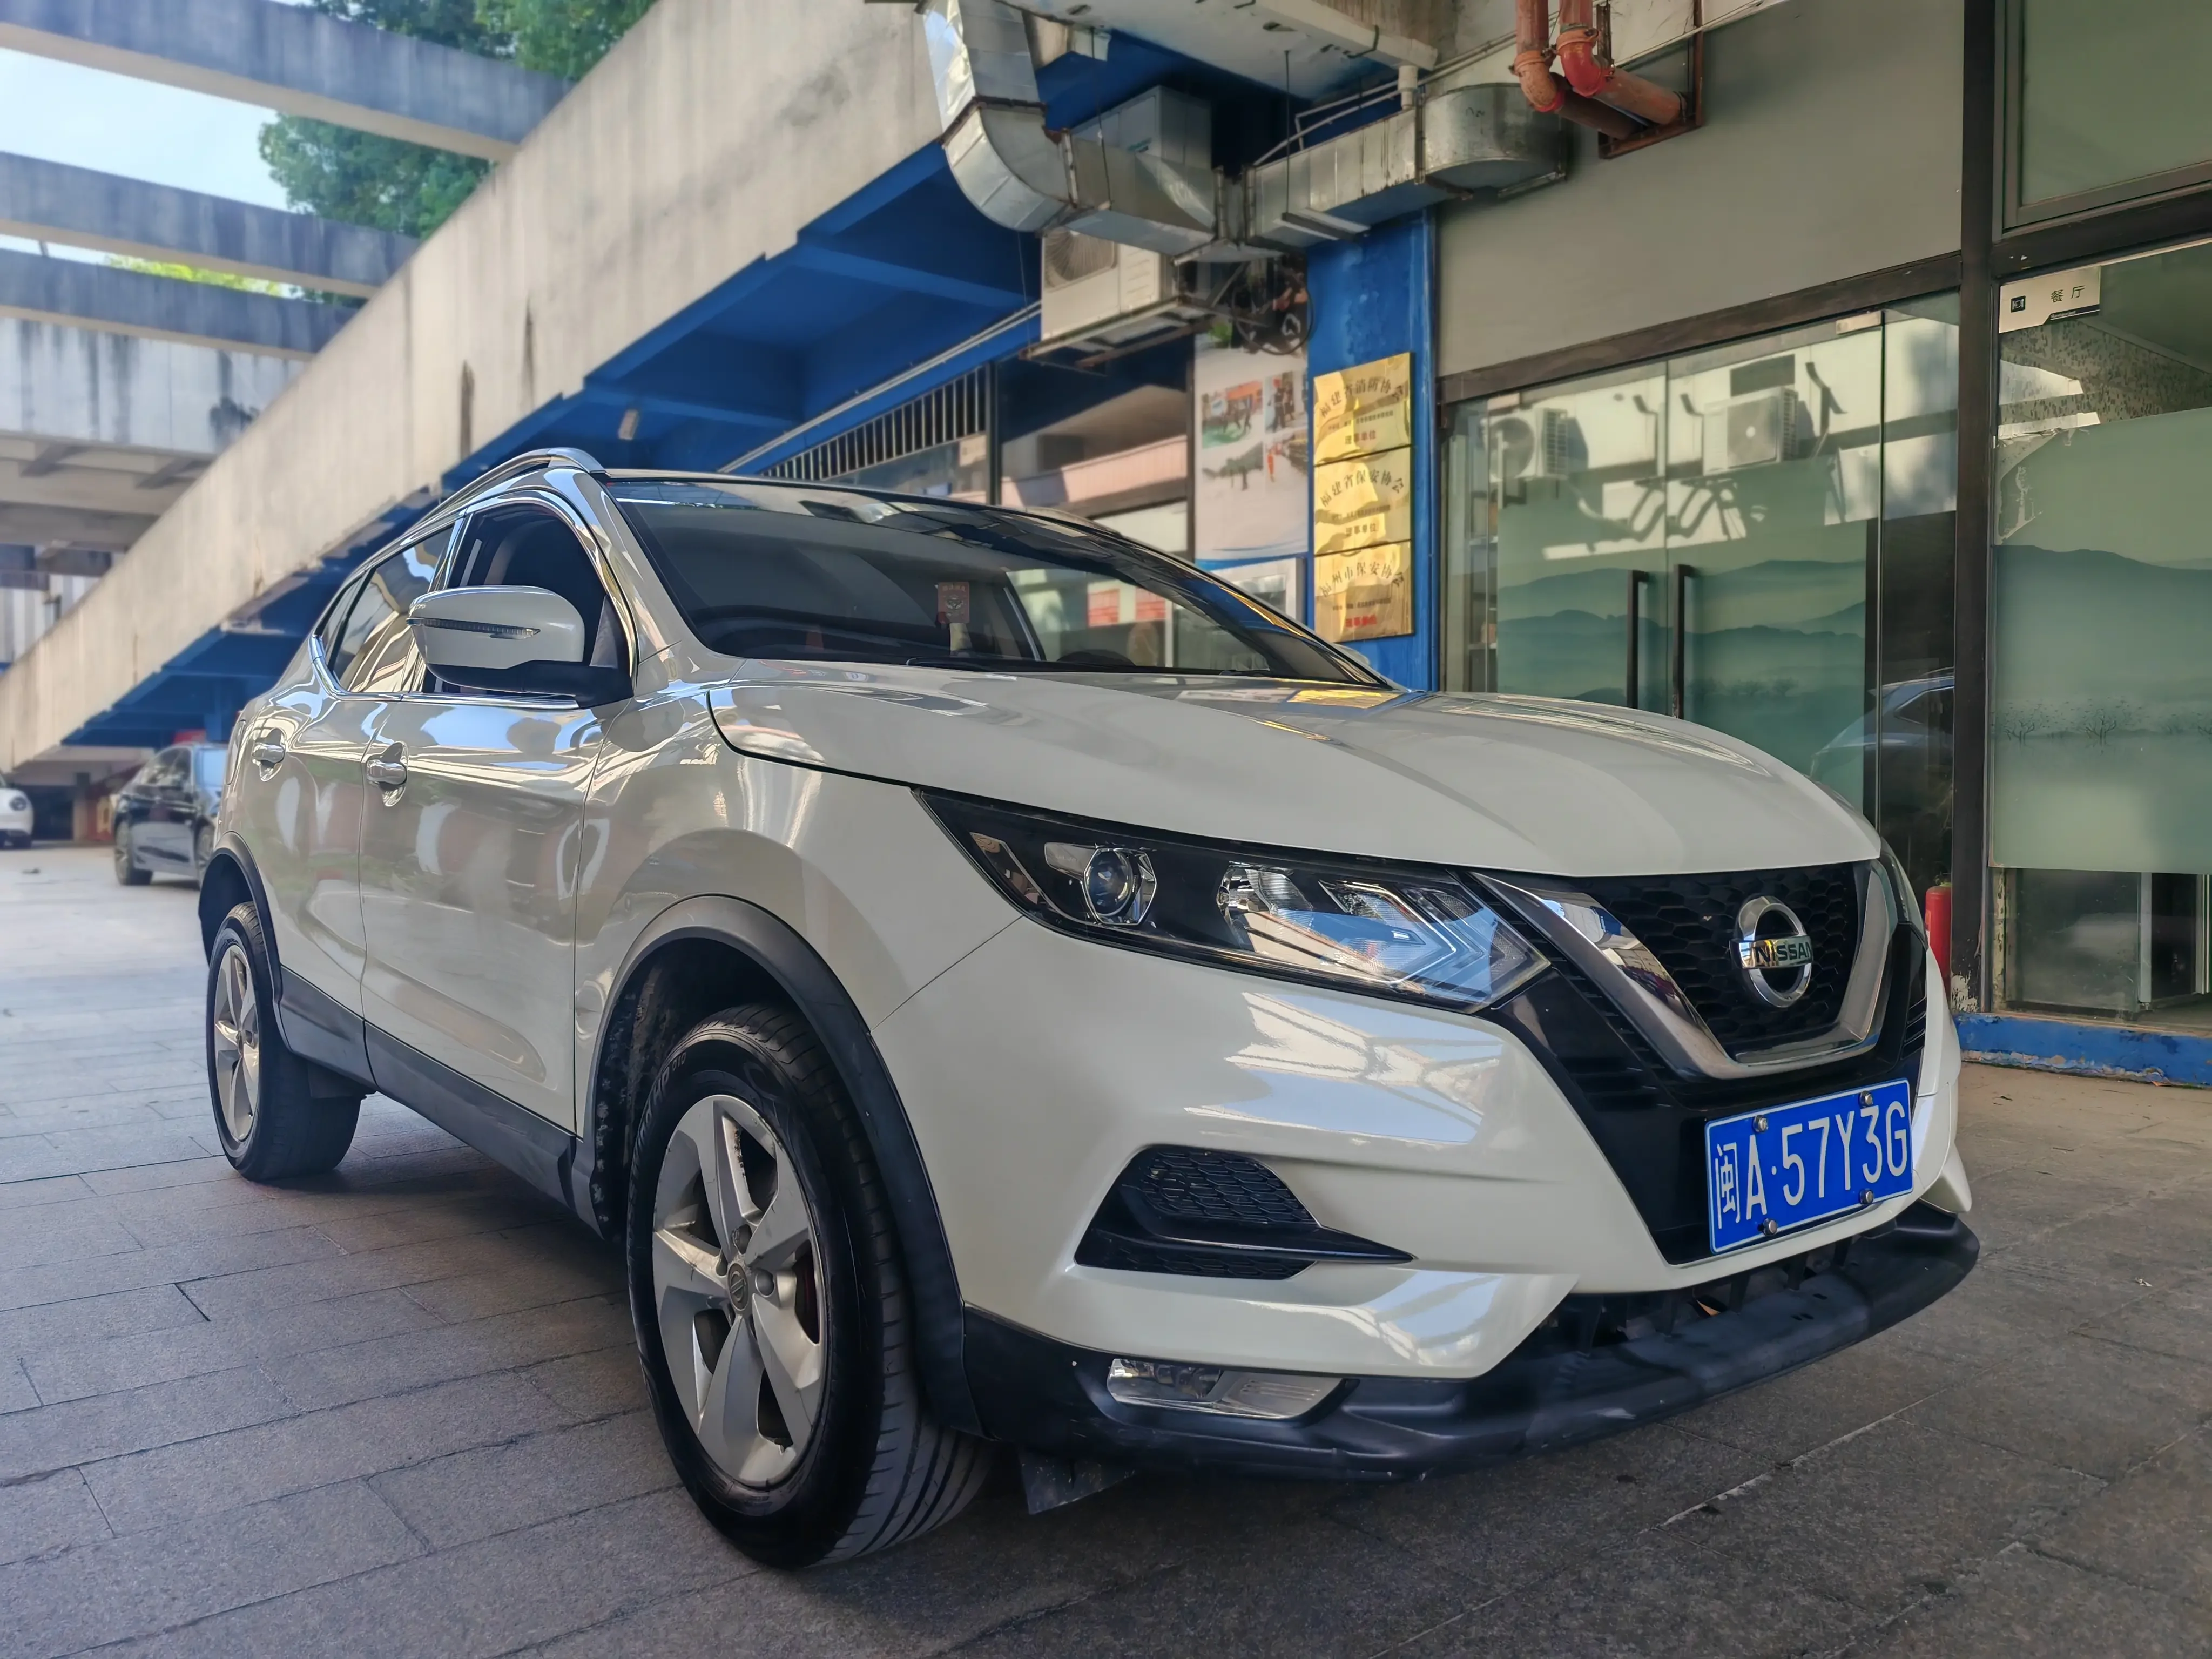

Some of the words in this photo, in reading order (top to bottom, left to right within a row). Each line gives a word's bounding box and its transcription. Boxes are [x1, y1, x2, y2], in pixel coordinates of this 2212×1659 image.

[2051, 285, 2085, 303] 餐厅
[1320, 469, 1404, 507] 福建省保安协会
[1755, 941, 1812, 963] NISSAN
